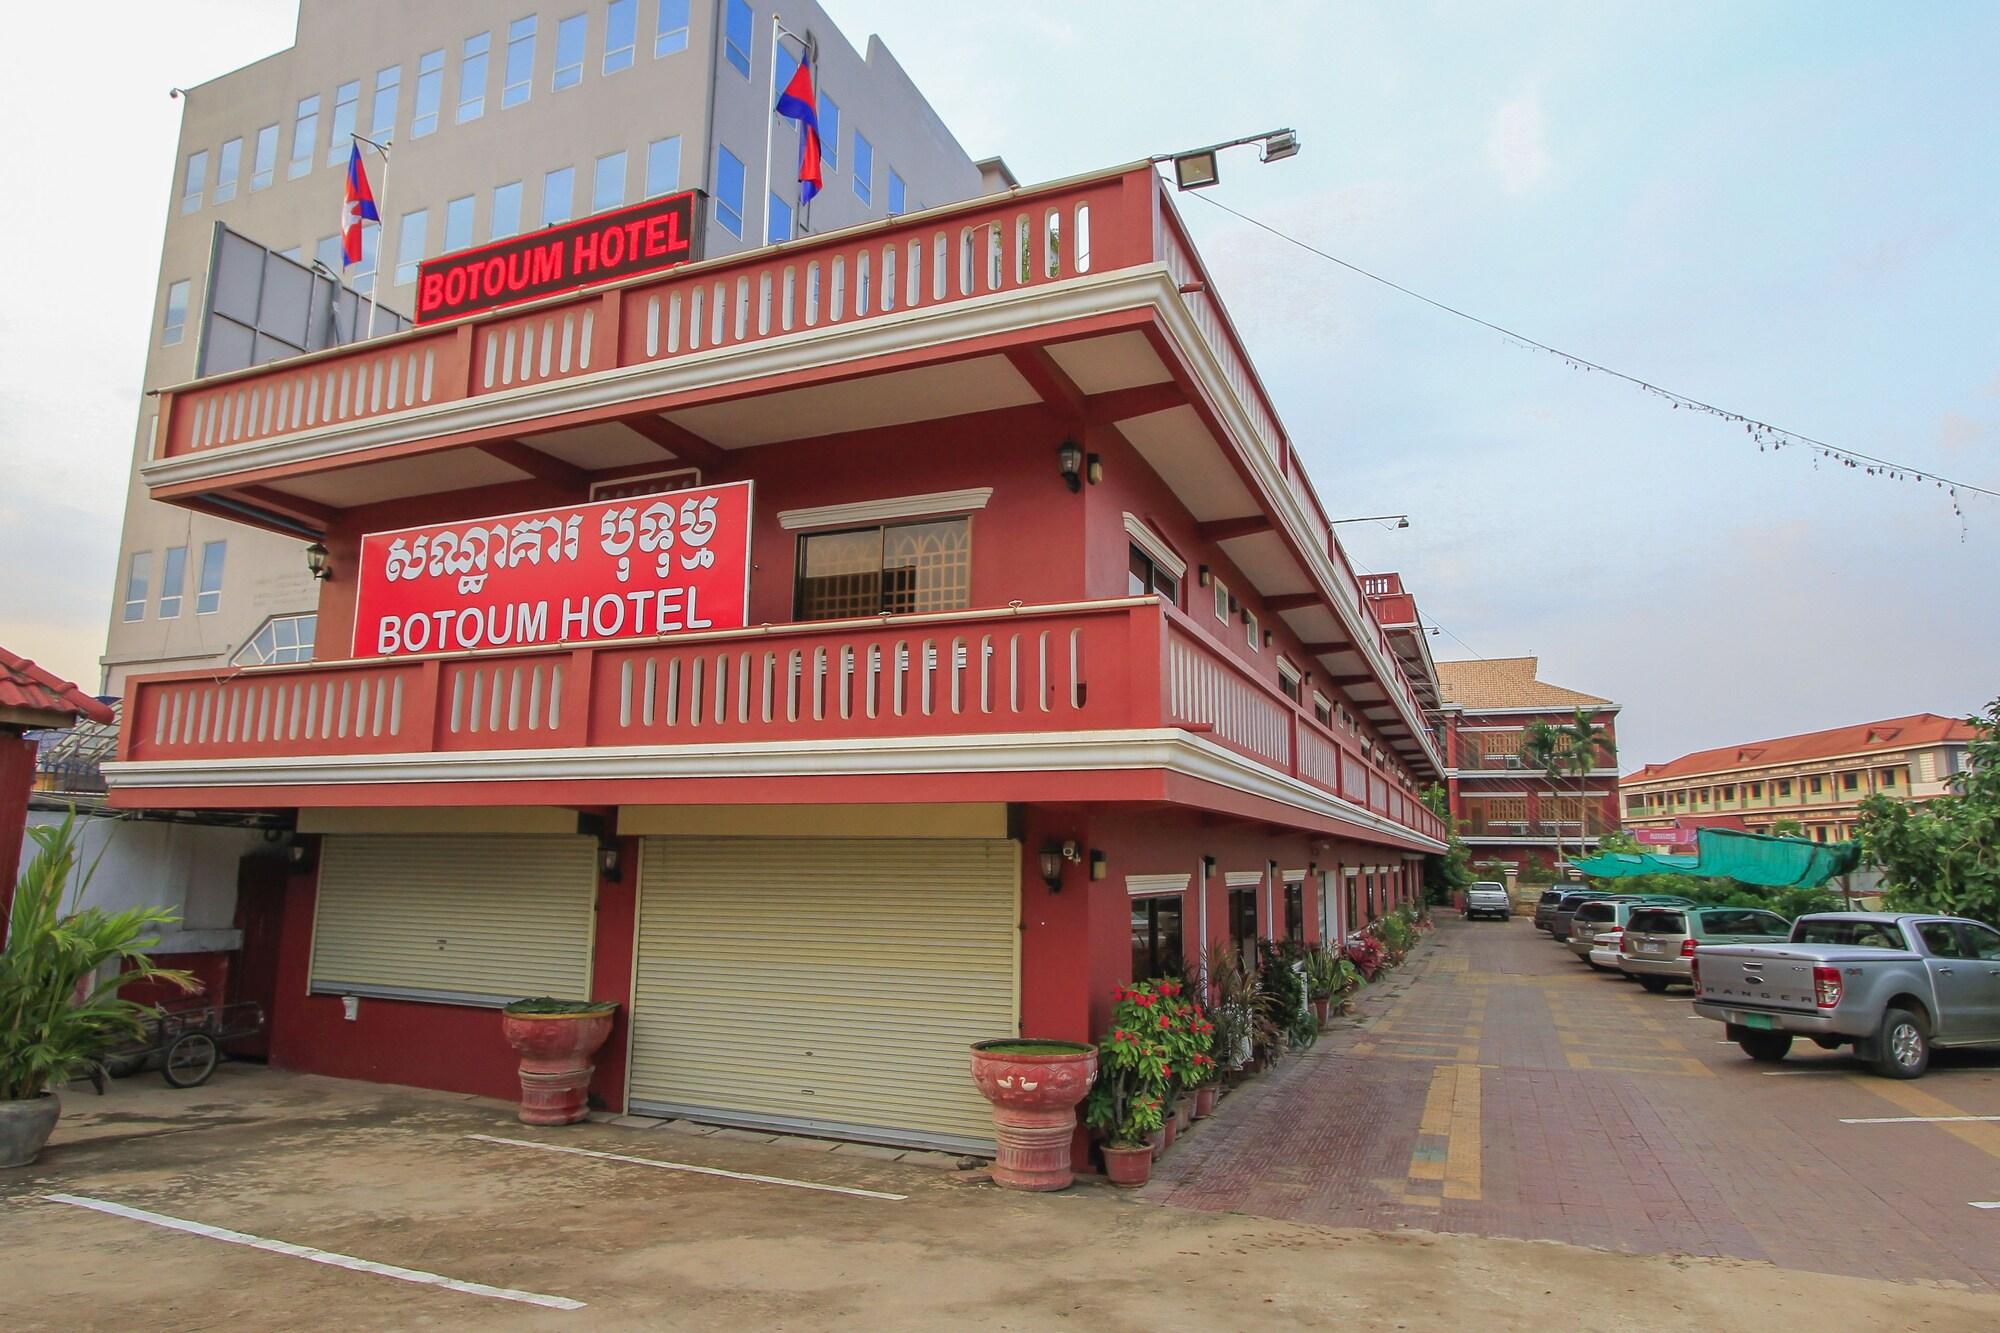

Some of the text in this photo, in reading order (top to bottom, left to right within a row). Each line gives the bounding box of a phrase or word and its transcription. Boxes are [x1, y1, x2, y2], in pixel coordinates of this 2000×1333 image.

[422, 211, 689, 311] BOTOUM HOTEL
[377, 585, 712, 655] BOTOUM HOTEL
[1705, 987, 1812, 1002] RANGER
